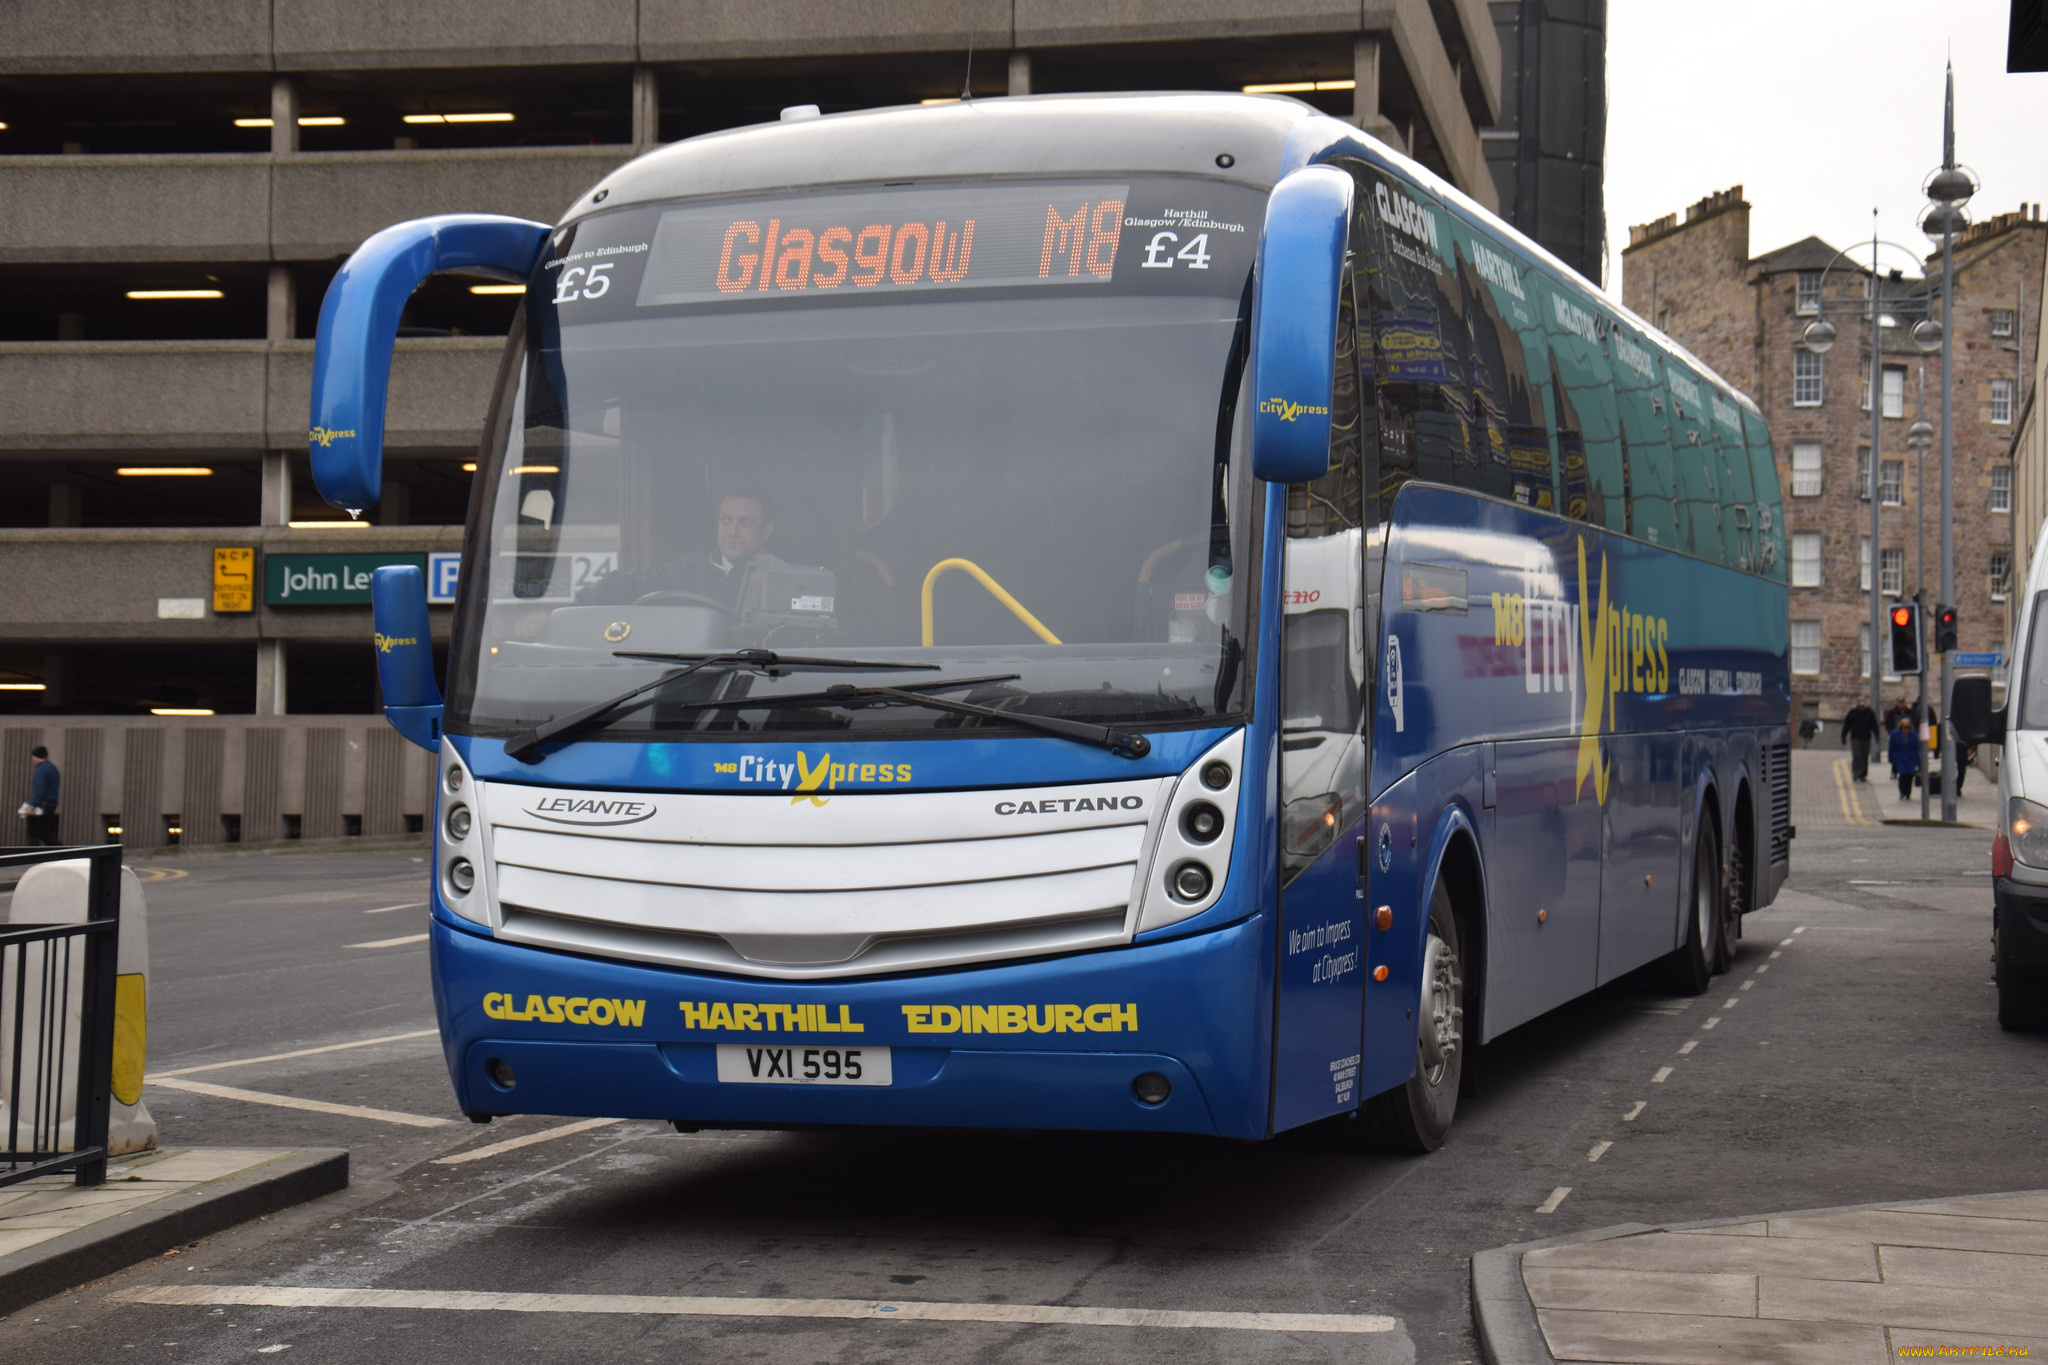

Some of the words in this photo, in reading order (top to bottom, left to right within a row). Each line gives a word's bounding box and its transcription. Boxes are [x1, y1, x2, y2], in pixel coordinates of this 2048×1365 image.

[1124, 217, 1176, 228] Glasgow
[1164, 209, 1208, 219] Harthill
[1376, 182, 1438, 250] GLASGOW
[544, 253, 583, 270] Glasgow
[584, 250, 595, 259] to
[596, 242, 648, 257] Edinburgh
[716, 219, 975, 293] Glasgow
[1038, 200, 1124, 277] M8
[1142, 231, 1211, 269] £4
[1392, 234, 1416, 264] Buchanan
[1416, 247, 1426, 268] Bus
[1426, 252, 1443, 276] Station
[552, 263, 614, 304] £5
[1471, 240, 1525, 301] HARTHILL
[1552, 292, 1597, 346] INGLISTON
[1260, 400, 1328, 422] CityXpress
[281, 566, 338, 597] John
[1491, 592, 1524, 647] M8
[714, 763, 738, 773] M8
[739, 751, 912, 807] CityXpress
[536, 797, 646, 816] LEVANTE
[994, 796, 1144, 816] CAETANO
[1289, 929, 1301, 955] We
[1301, 924, 1316, 952] aim
[1317, 925, 1325, 947] to
[1325, 920, 1351, 949] Impress
[1312, 959, 1321, 983] at
[482, 992, 646, 1027] GLASGOW
[679, 1001, 864, 1032] HARTHILL
[901, 1003, 1138, 1033] EDINBURGH
[803, 1050, 862, 1079] 595
